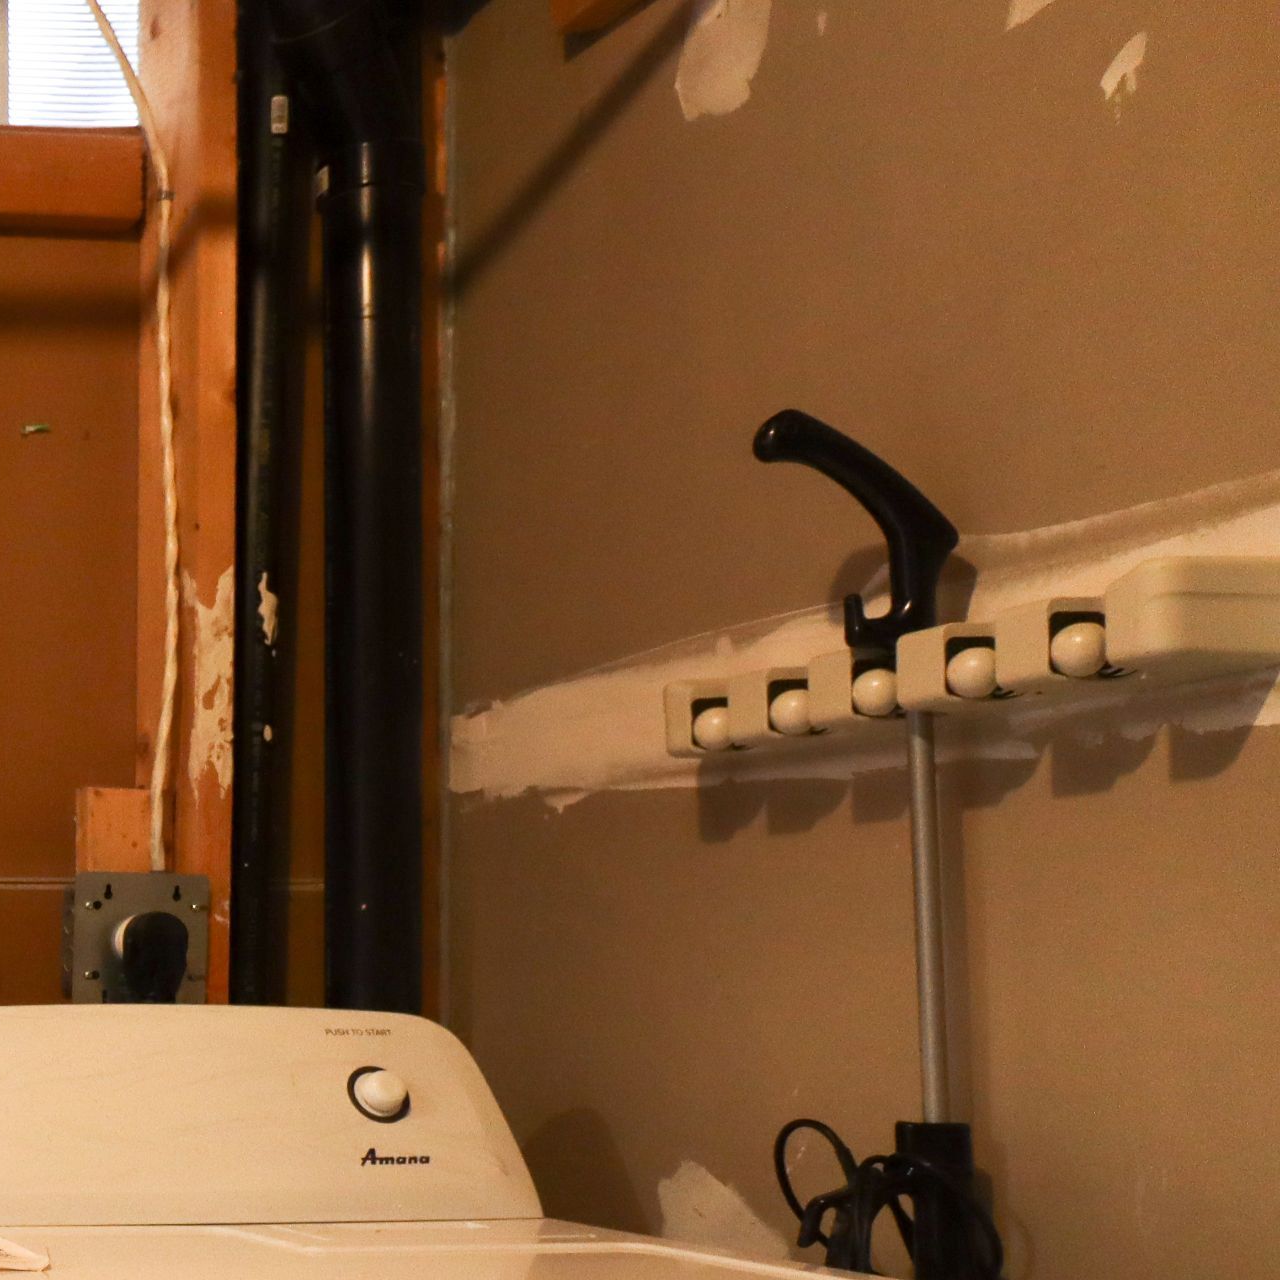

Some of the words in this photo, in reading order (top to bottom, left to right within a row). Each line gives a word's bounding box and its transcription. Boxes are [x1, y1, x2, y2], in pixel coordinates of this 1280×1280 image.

[324, 1028, 350, 1036] PUSH
[351, 1028, 364, 1036] TO
[365, 1028, 392, 1036] START
[361, 1148, 430, 1166] Amana
